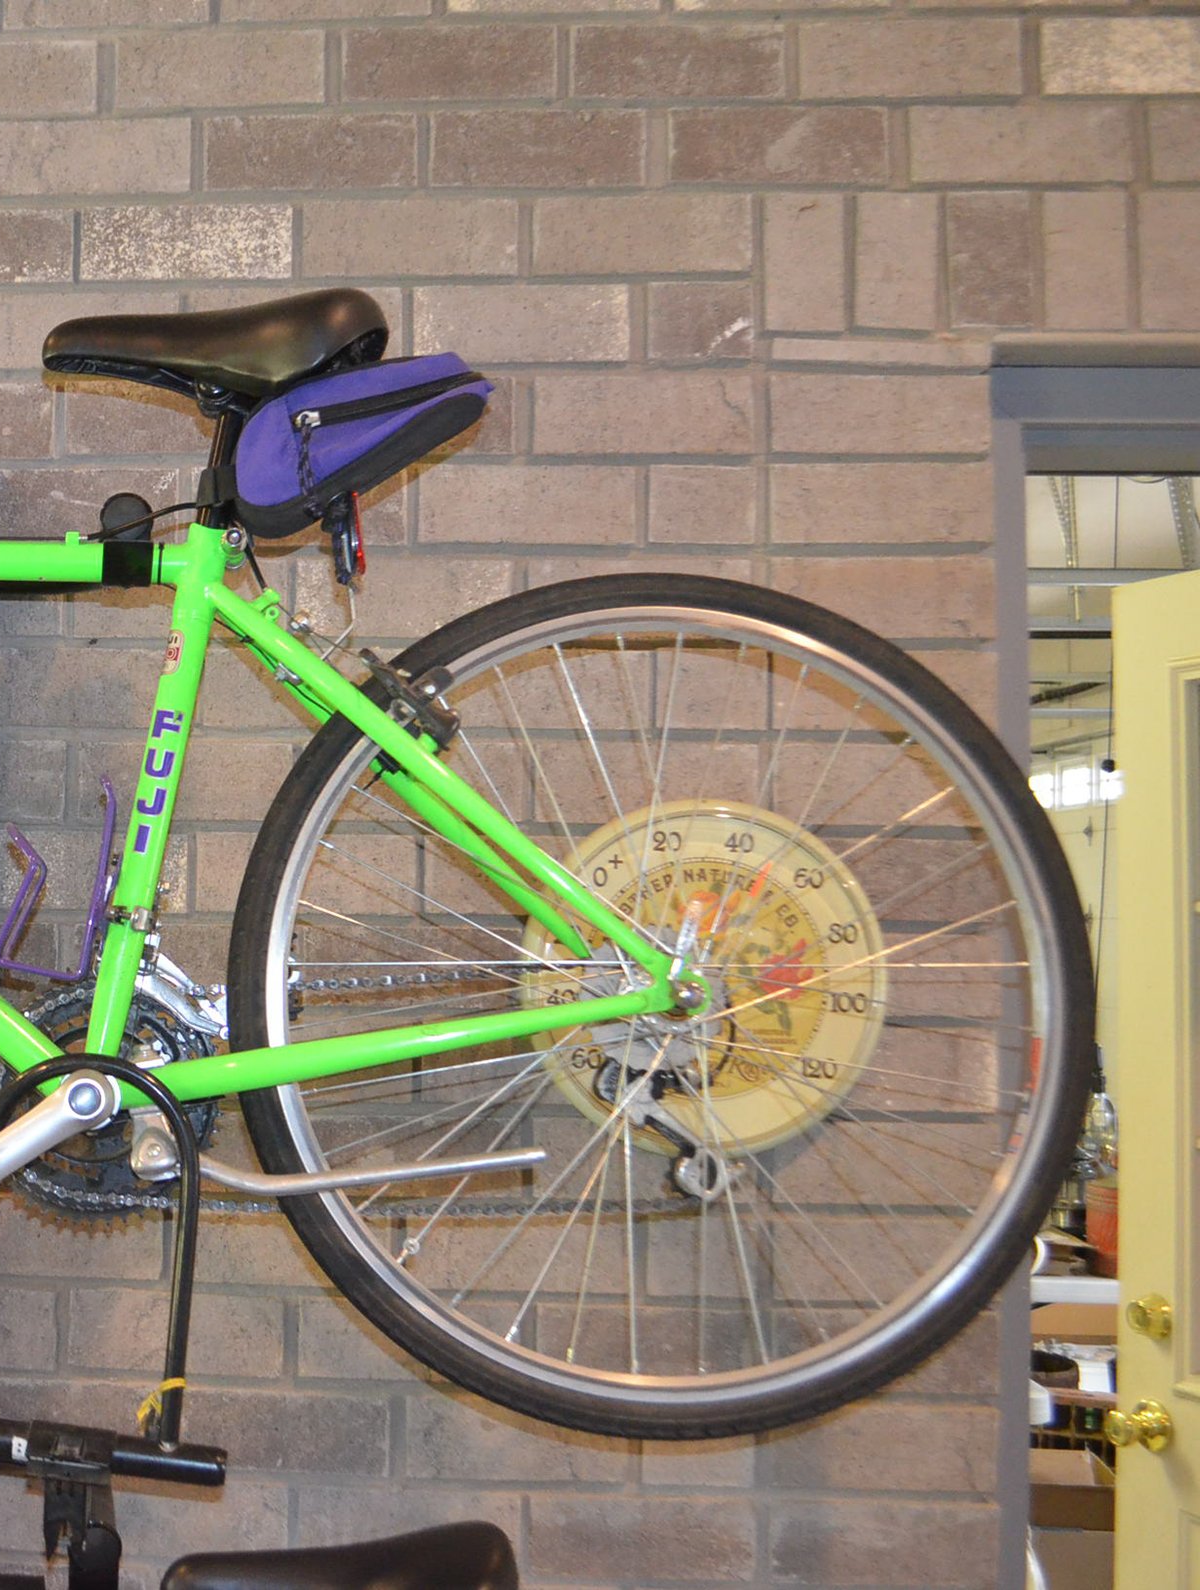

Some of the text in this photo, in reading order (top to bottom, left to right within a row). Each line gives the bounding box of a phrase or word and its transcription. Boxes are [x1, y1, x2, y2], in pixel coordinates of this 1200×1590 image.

[134, 709, 184, 854] FUJI
[653, 831, 682, 852] 20
[725, 832, 755, 854] 40
[794, 868, 825, 889] 60
[615, 873, 677, 921] OTHER
[828, 923, 858, 944] 80
[830, 992, 868, 1013] 100
[571, 1048, 603, 1069] 60
[802, 1057, 838, 1080] 120
